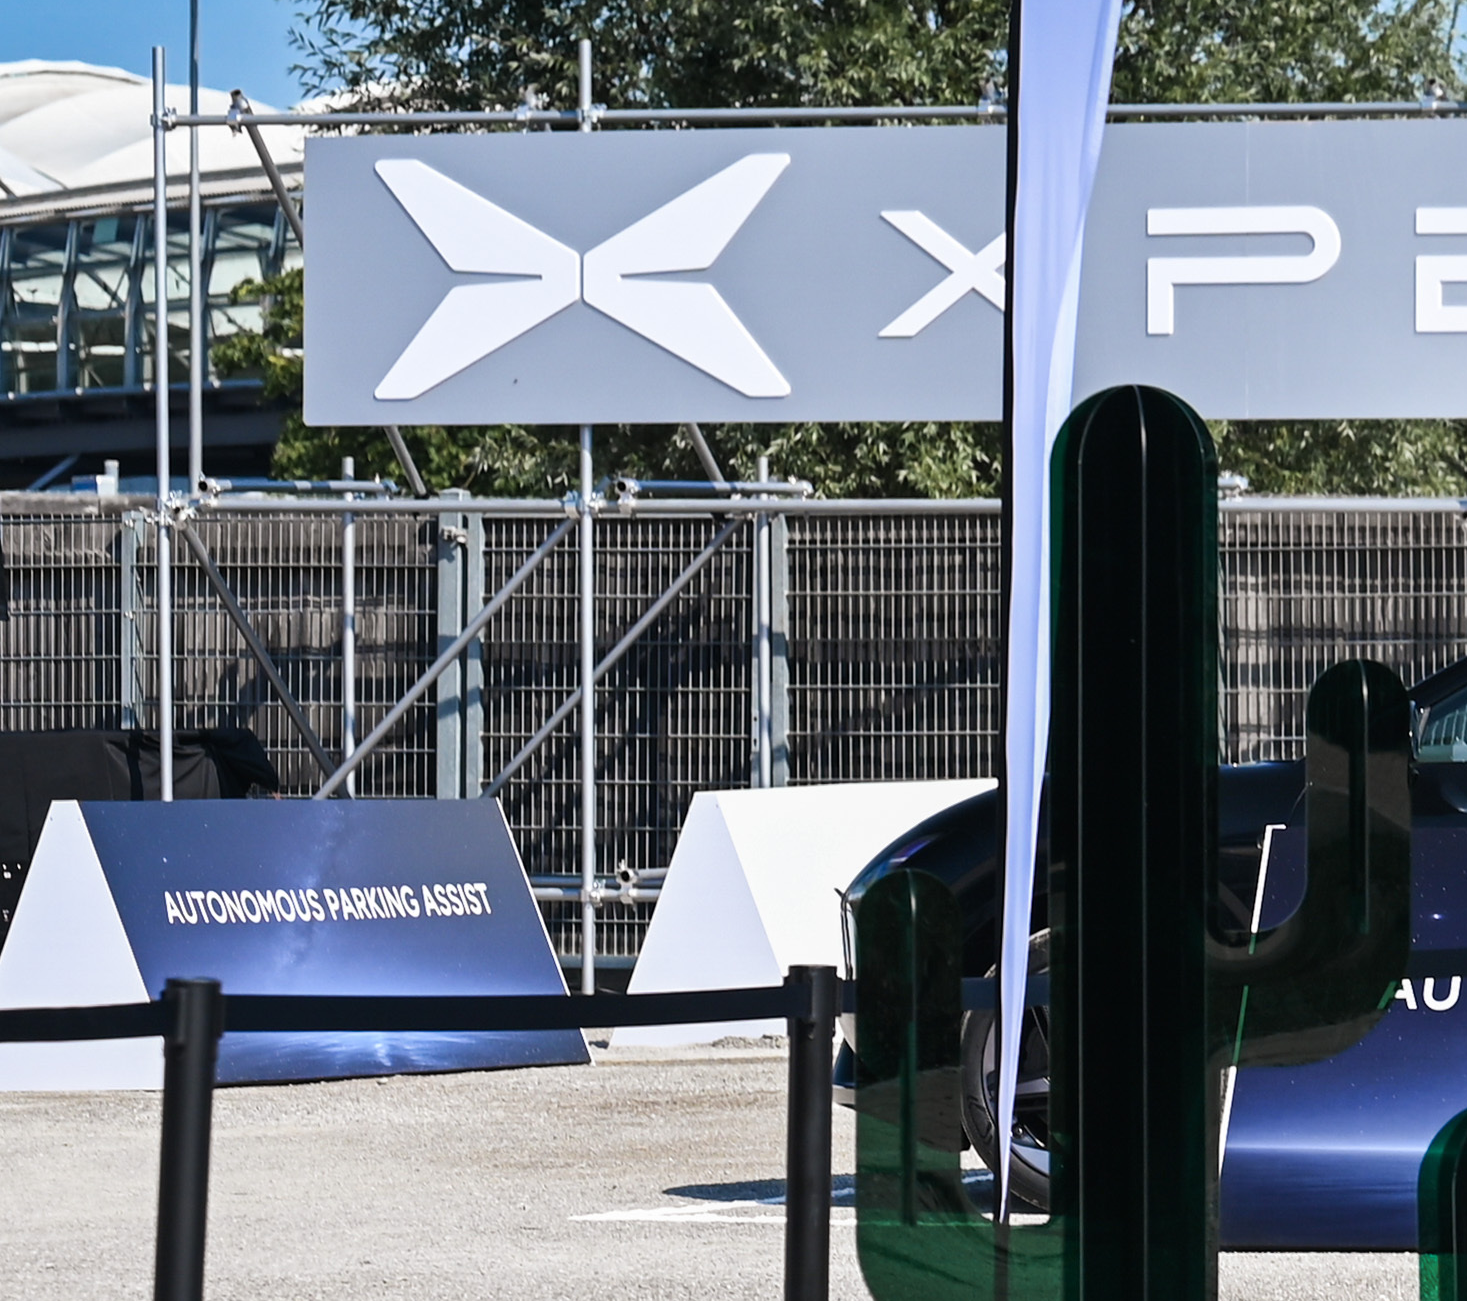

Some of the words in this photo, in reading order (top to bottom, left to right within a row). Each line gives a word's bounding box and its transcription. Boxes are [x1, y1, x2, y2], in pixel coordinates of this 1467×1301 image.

[164, 888, 326, 925] AUTONOMOUS
[322, 885, 421, 921] PARKING
[421, 883, 492, 917] ASSIST
